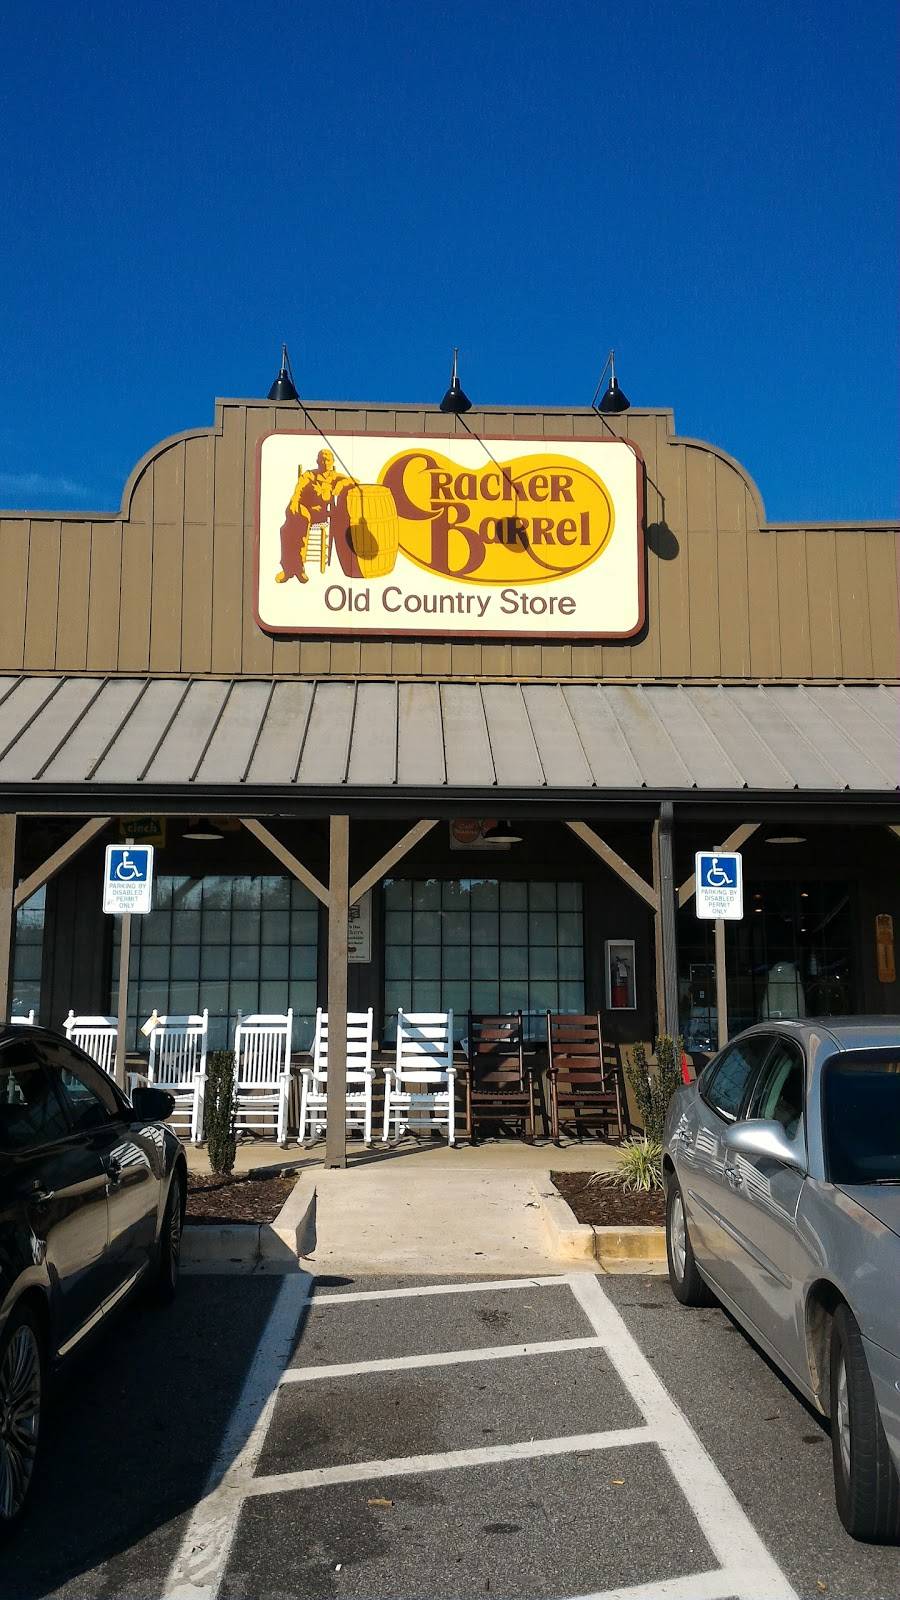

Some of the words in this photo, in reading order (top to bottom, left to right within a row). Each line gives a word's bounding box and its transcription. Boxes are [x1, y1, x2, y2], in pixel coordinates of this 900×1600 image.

[324, 585, 370, 612] Old
[381, 586, 492, 617] Country
[500, 588, 577, 615] Store
